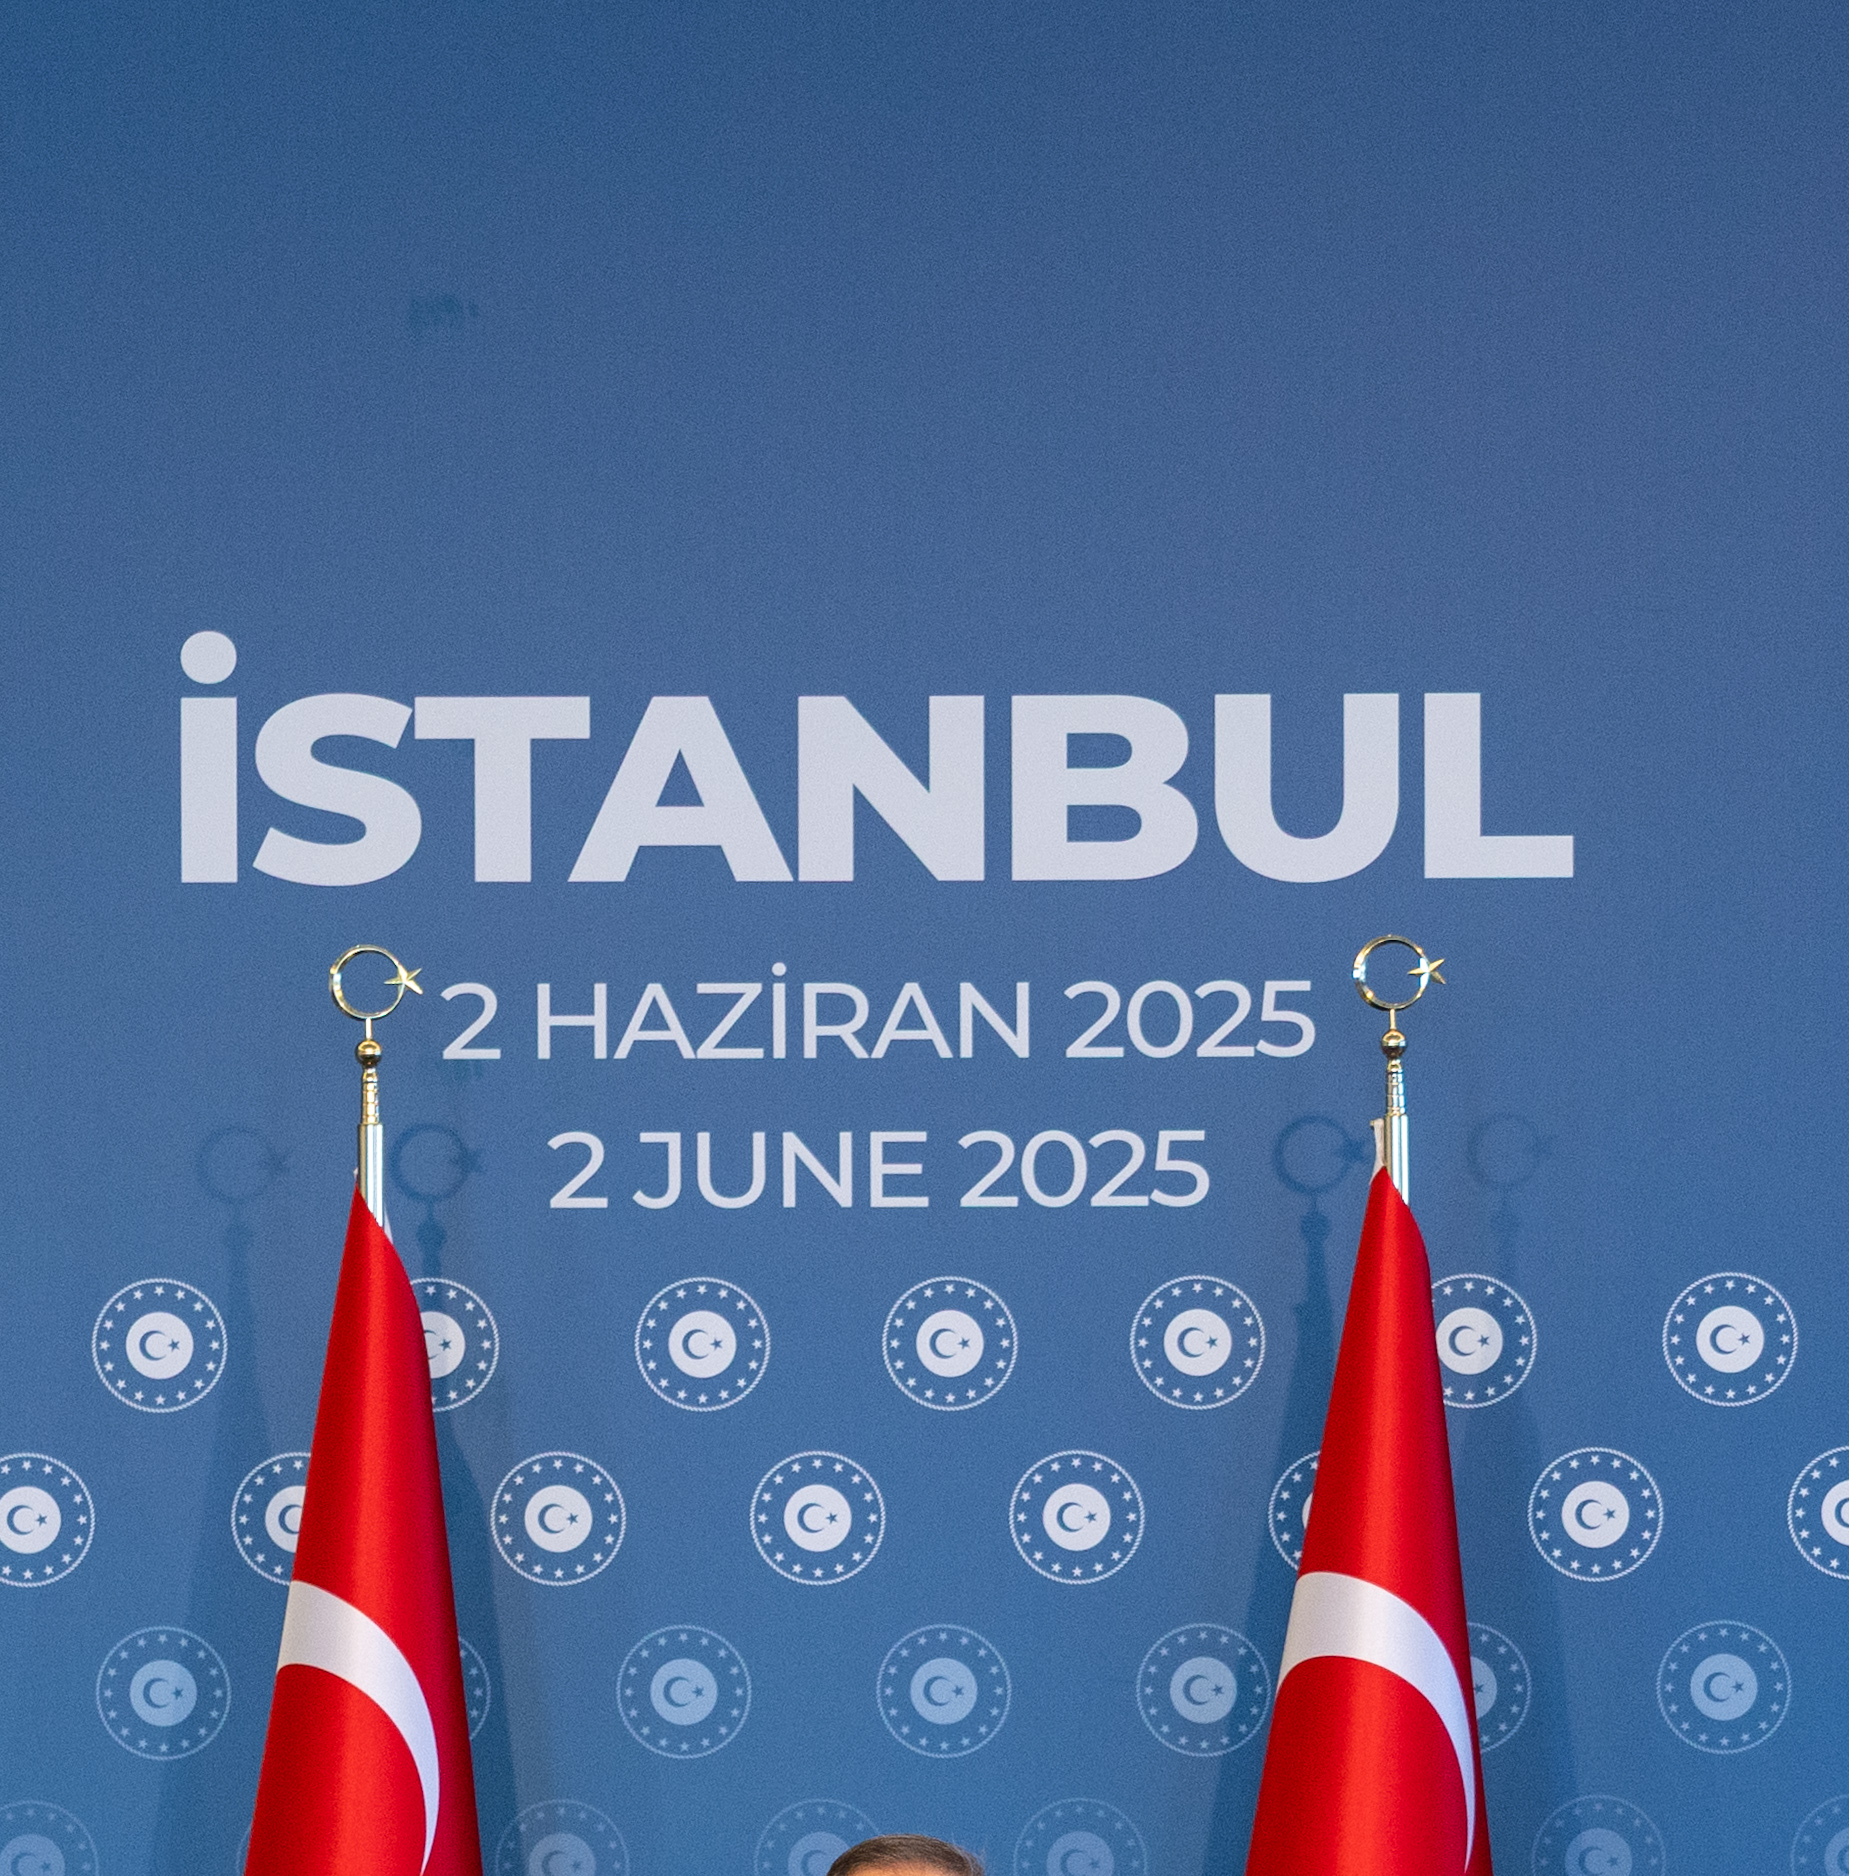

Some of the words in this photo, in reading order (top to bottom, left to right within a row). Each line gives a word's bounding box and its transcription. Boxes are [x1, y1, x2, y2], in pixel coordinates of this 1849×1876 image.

[179, 630, 1575, 887] İSTANBUL
[440, 981, 502, 1060] 2
[536, 961, 1030, 1060] HAZİRAN
[1063, 979, 1317, 1059] 2025
[547, 1130, 609, 1209] 2
[632, 1130, 930, 1210] JUNE
[957, 1128, 1211, 1208] 2025
